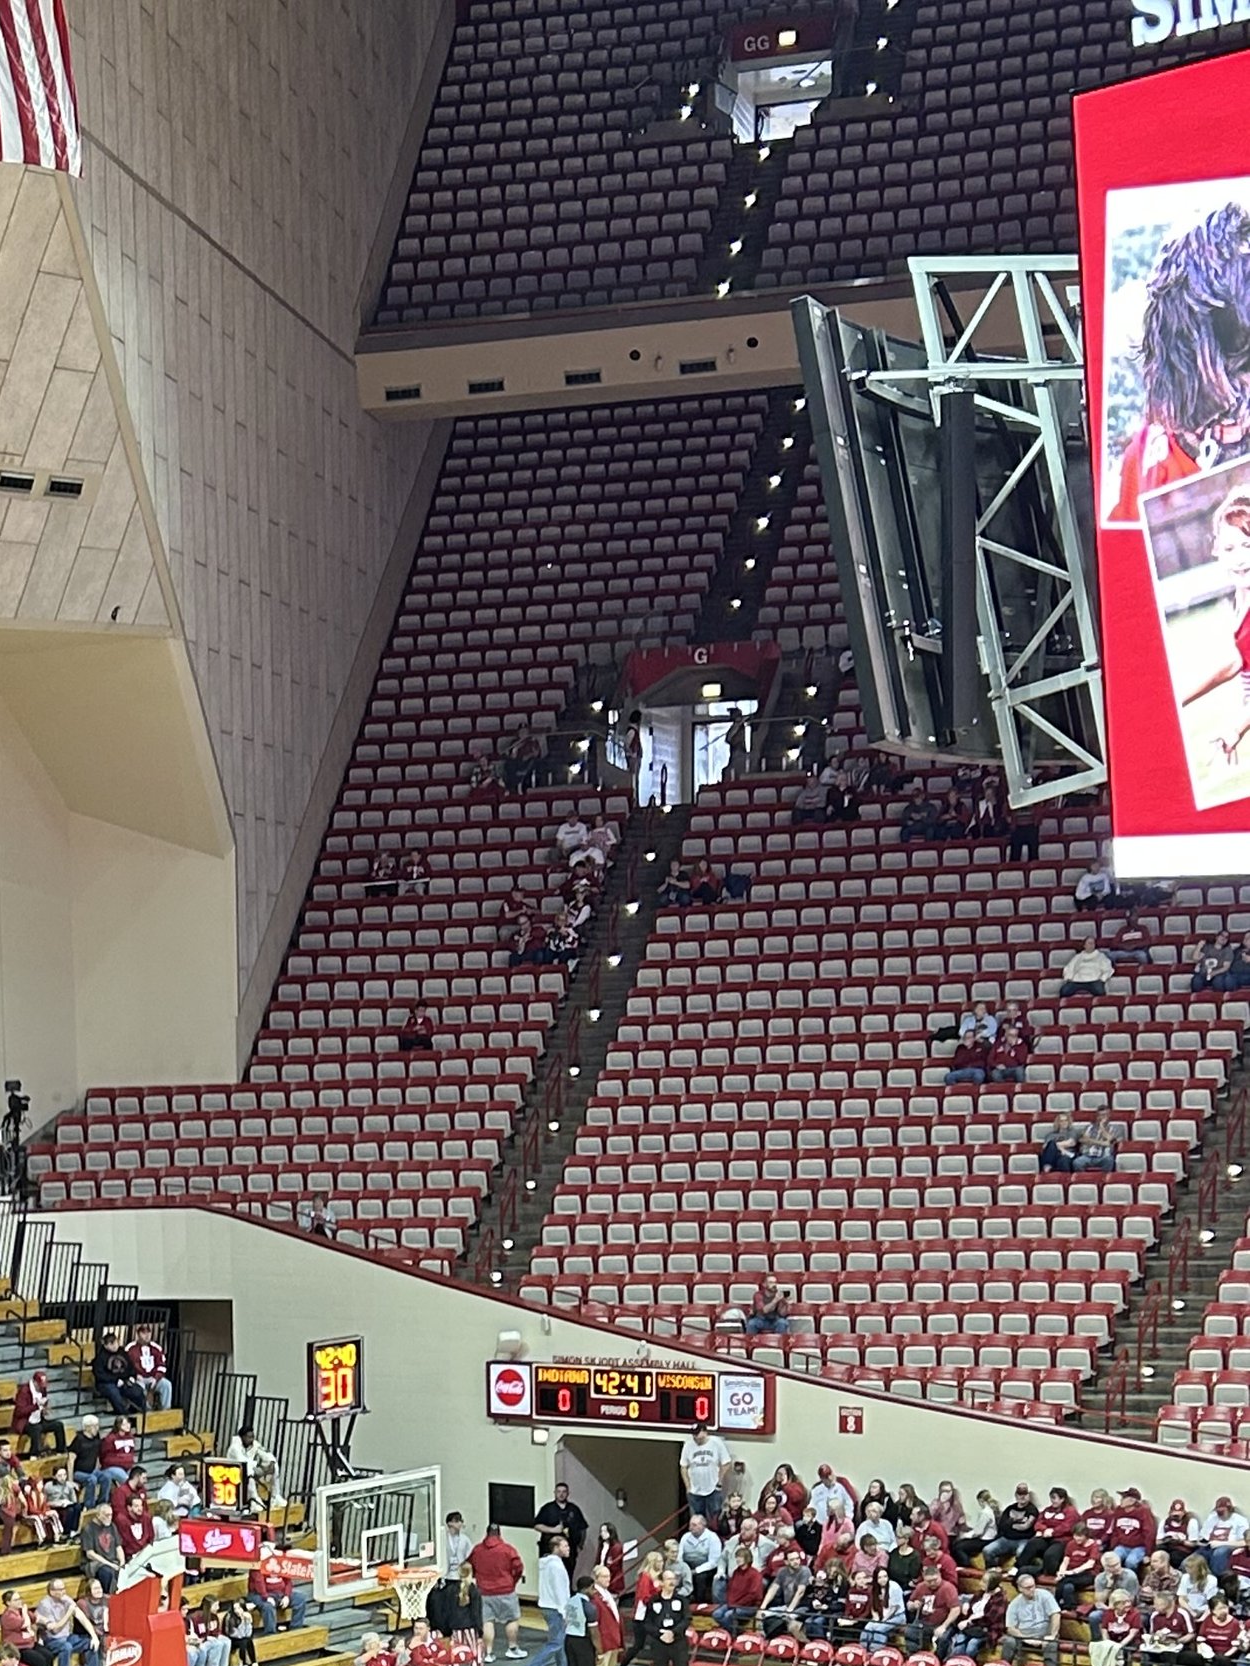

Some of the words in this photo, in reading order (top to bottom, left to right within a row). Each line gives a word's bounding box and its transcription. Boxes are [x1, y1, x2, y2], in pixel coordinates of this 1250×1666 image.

[744, 35, 770, 52] GG
[694, 648, 708, 664] G
[537, 1368, 589, 1384] INDIANA
[595, 1371, 651, 1395] 42:41
[657, 1374, 712, 1390] WISCONSIN
[319, 1368, 353, 1409] 30
[558, 1388, 571, 1412] 0
[730, 1392, 754, 1406] GO
[695, 1397, 709, 1420] 0
[846, 1415, 856, 1431] 8
